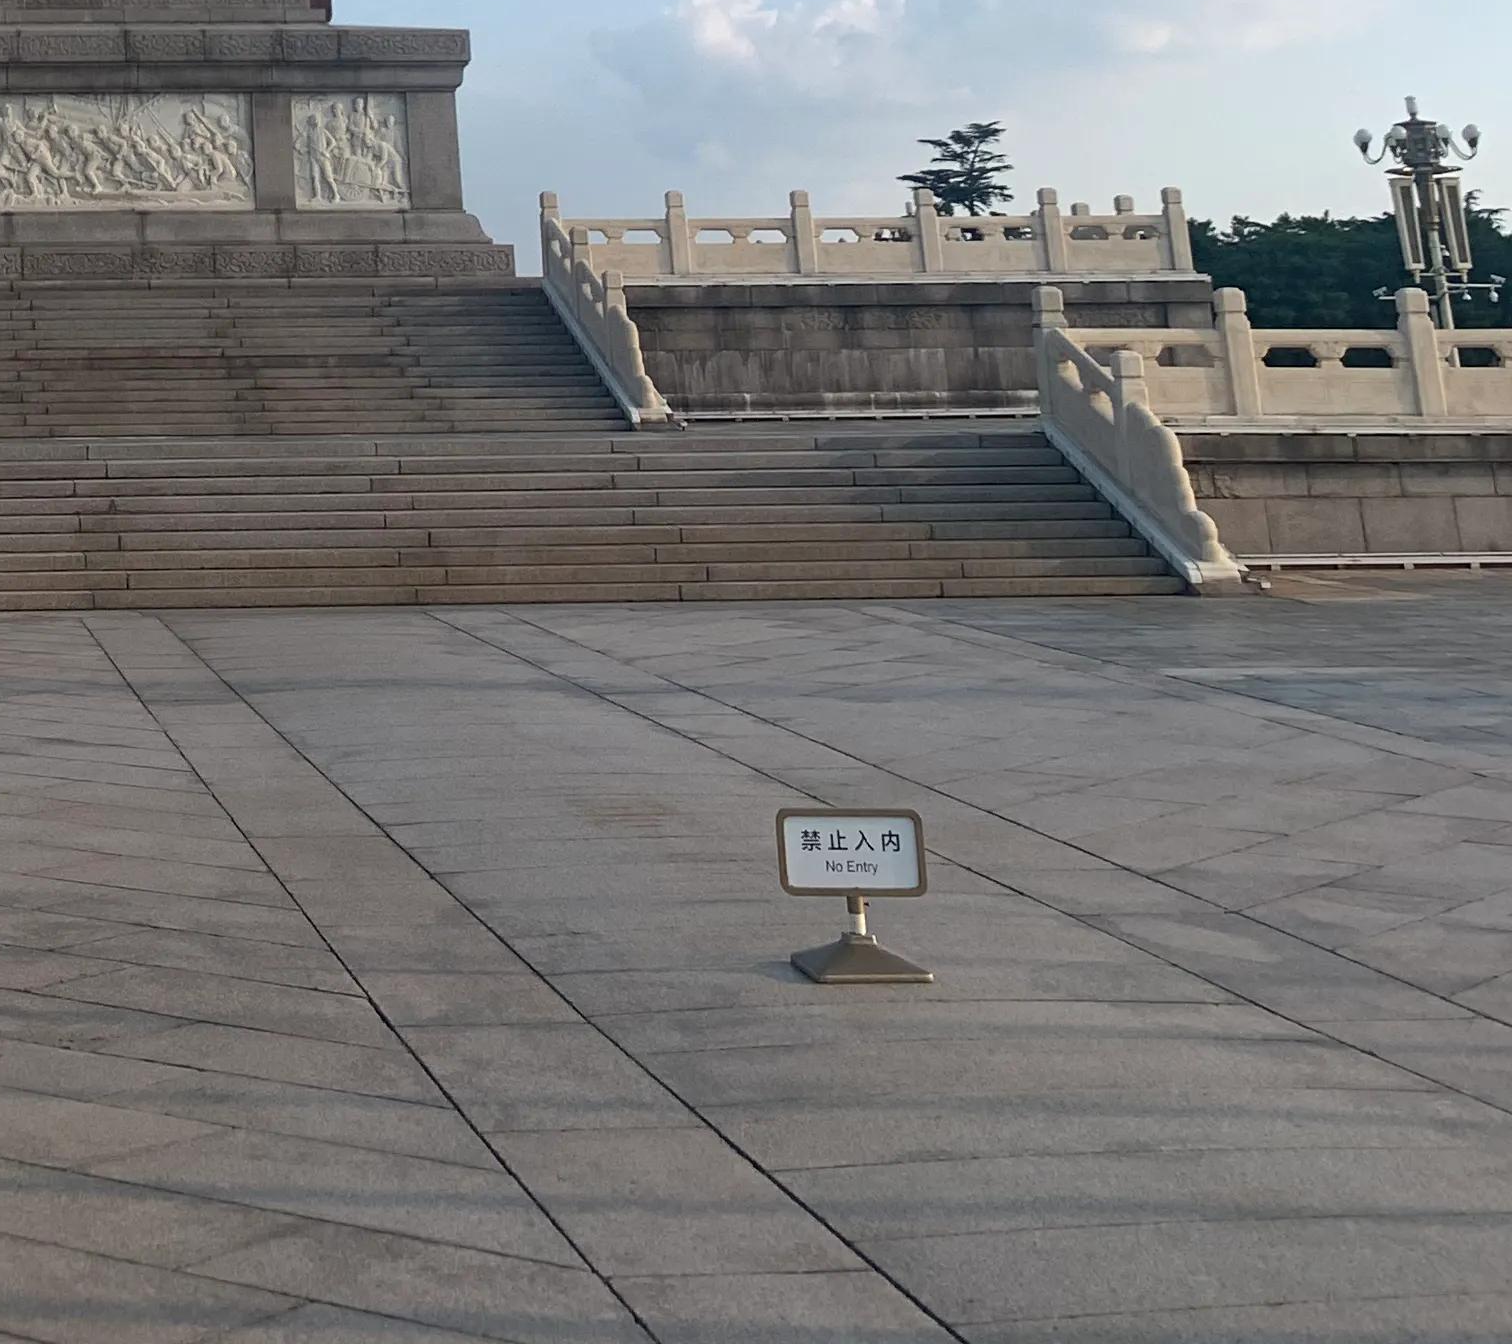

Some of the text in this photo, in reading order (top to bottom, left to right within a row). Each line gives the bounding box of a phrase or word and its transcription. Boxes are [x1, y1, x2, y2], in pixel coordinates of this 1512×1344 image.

[801, 829, 901, 852] 禁止入内
[825, 860, 878, 876] No Entry
